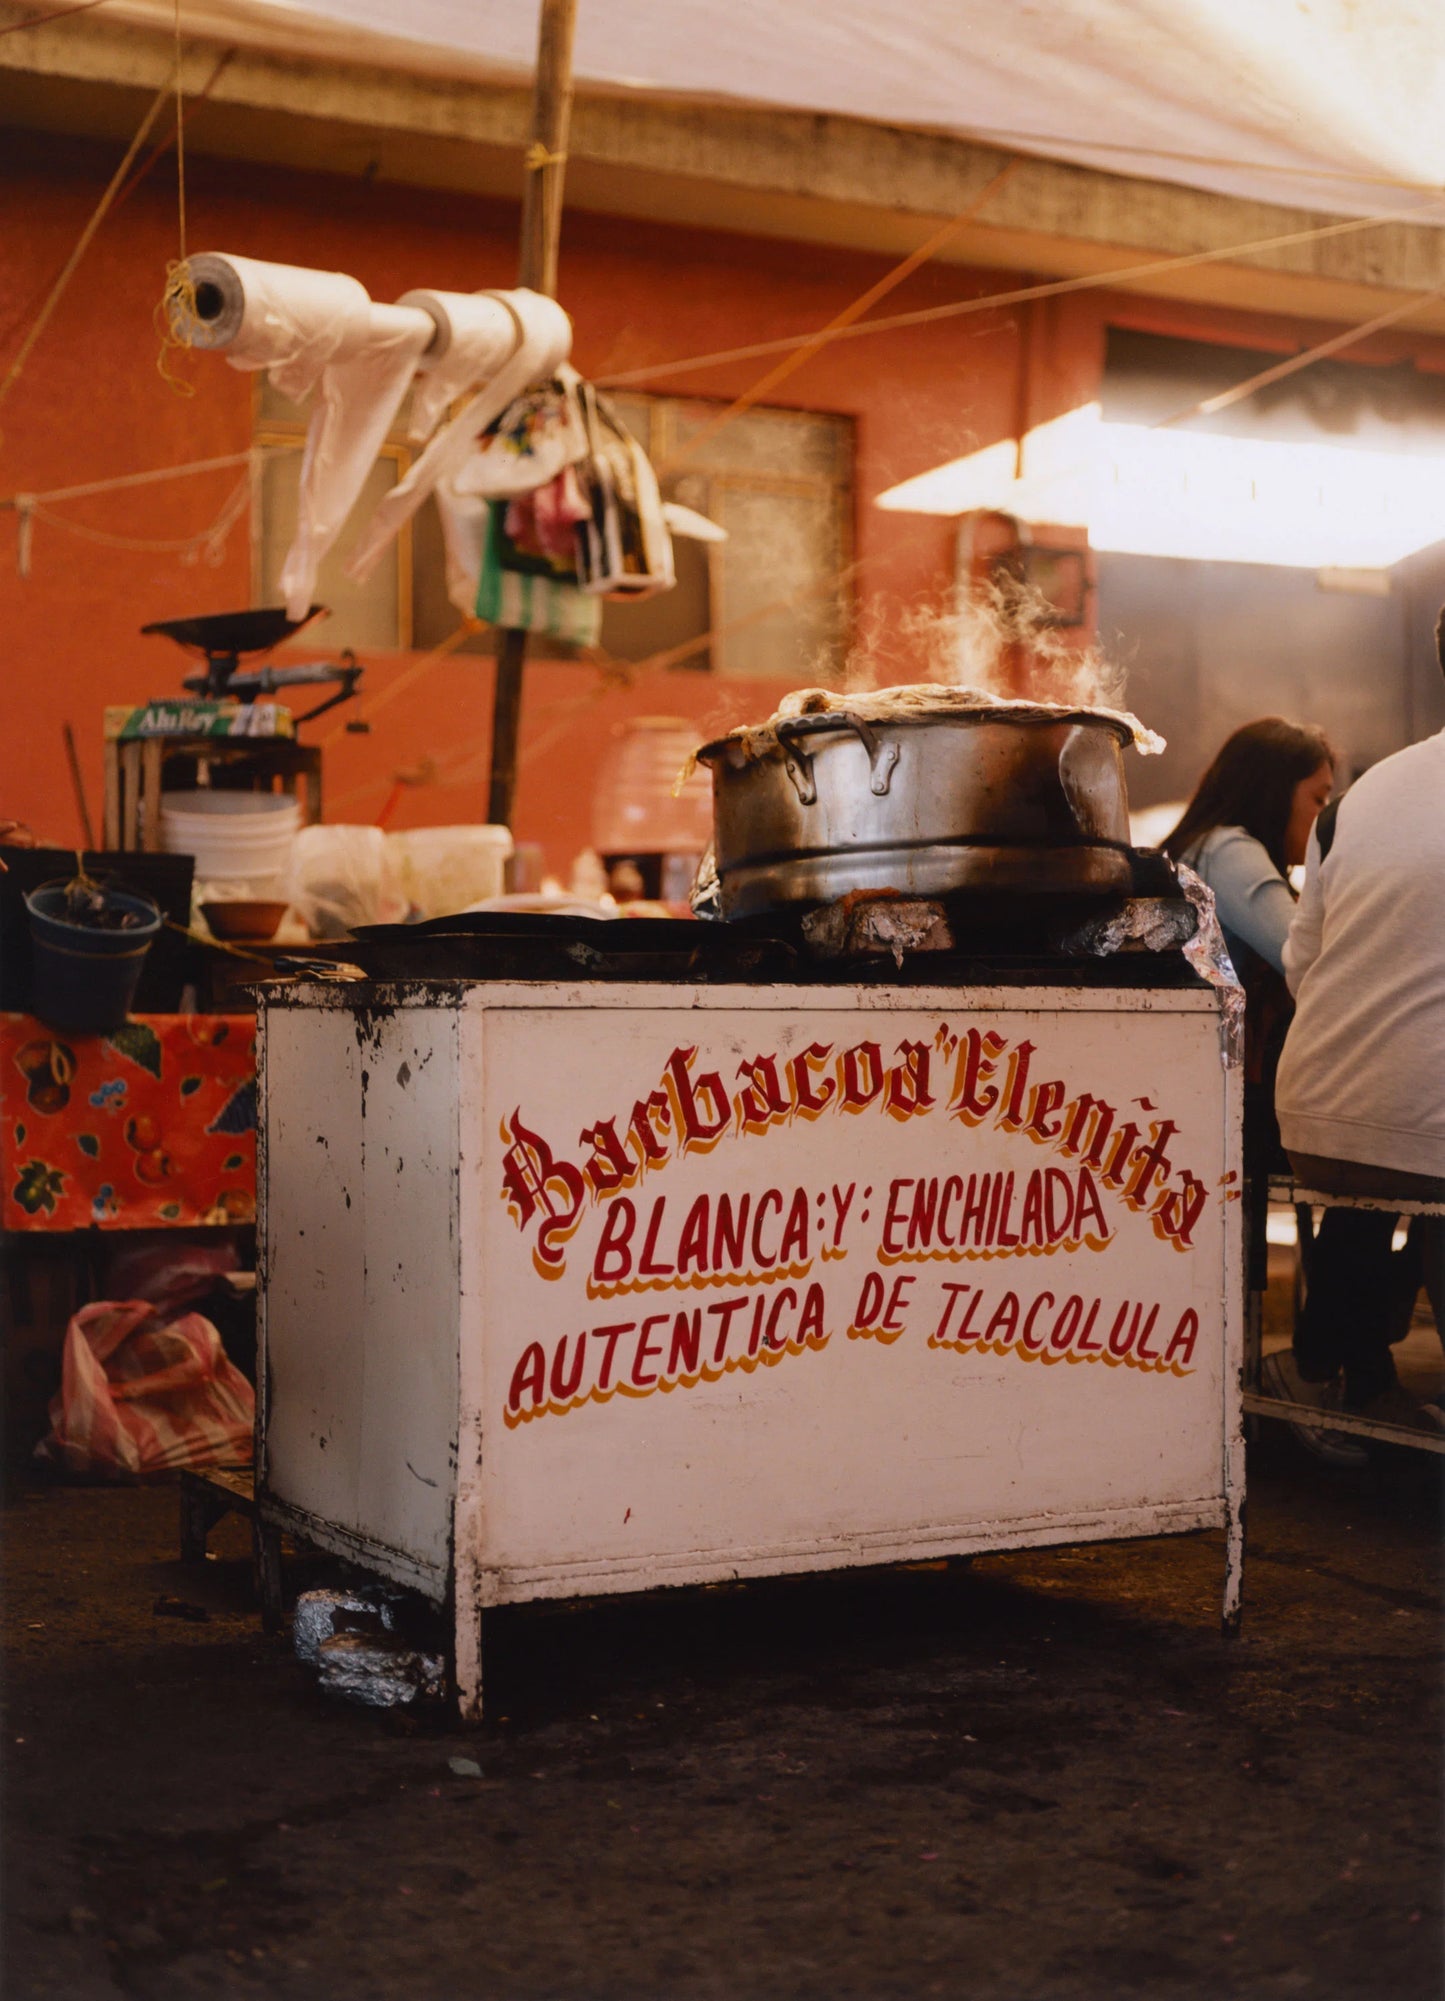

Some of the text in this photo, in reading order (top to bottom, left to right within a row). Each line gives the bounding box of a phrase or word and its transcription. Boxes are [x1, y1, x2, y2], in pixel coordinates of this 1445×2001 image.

[501, 1039, 938, 1268] Barbacoa
[881, 1167, 1110, 1258] ENCHILADA
[506, 1272, 1200, 1417] AUTENTICA DE TLACOLULA
